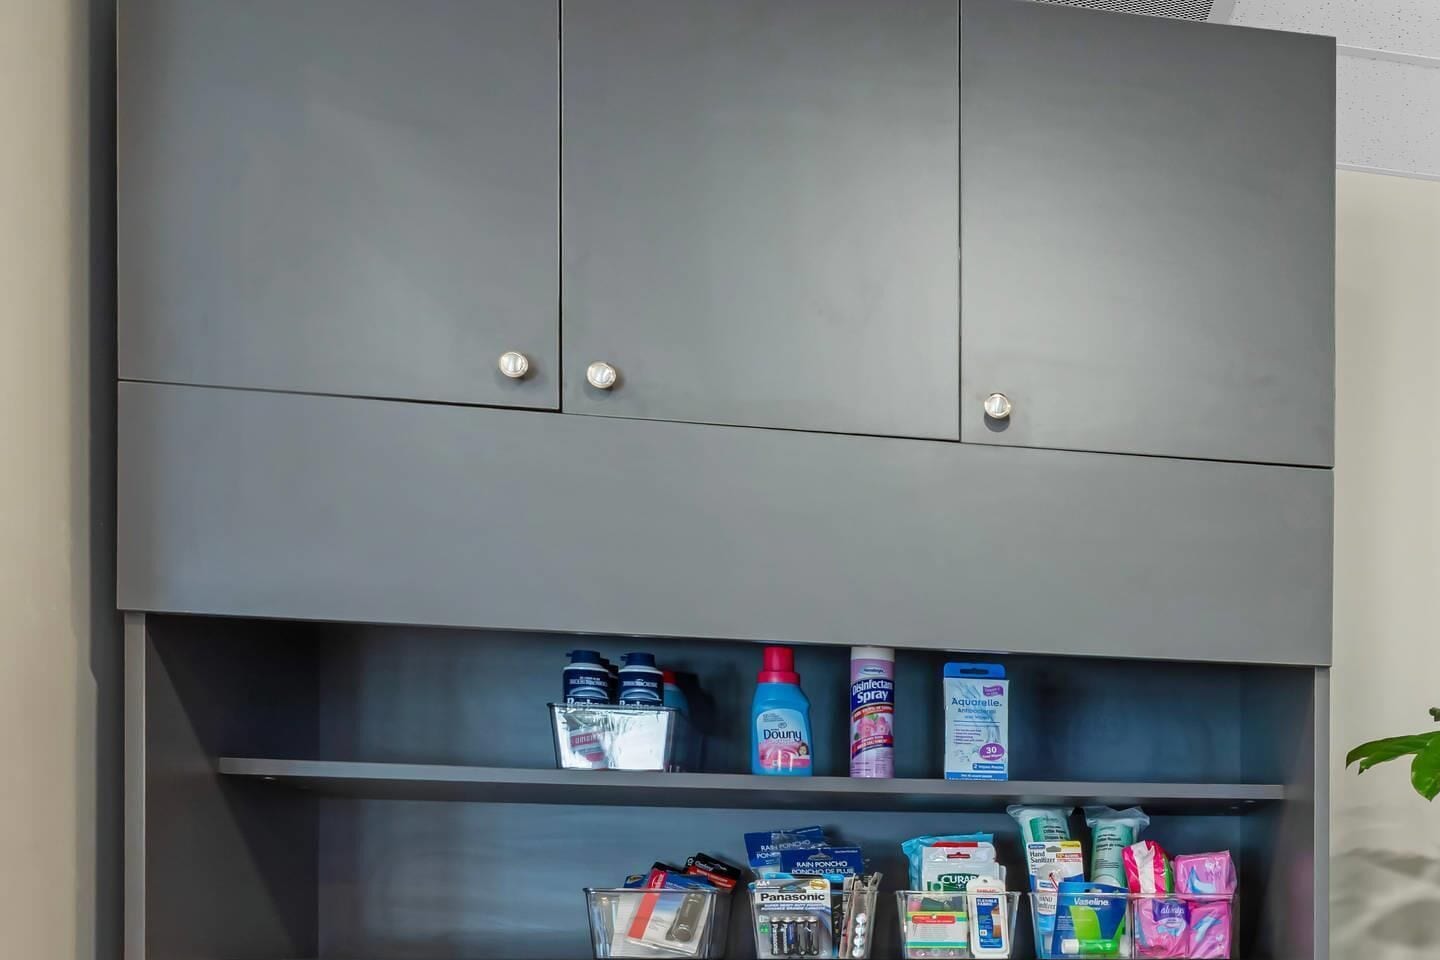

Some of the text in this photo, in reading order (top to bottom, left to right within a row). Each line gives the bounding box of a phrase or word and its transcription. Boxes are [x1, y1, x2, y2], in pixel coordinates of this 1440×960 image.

[857, 690, 889, 703] Spray
[763, 729, 802, 742] Downy
[985, 746, 997, 754] 30
[779, 839, 811, 849] PONCHO
[814, 860, 848, 868] PONCHO
[760, 893, 825, 902] Panasonic
[1073, 897, 1110, 906] Vaseline
